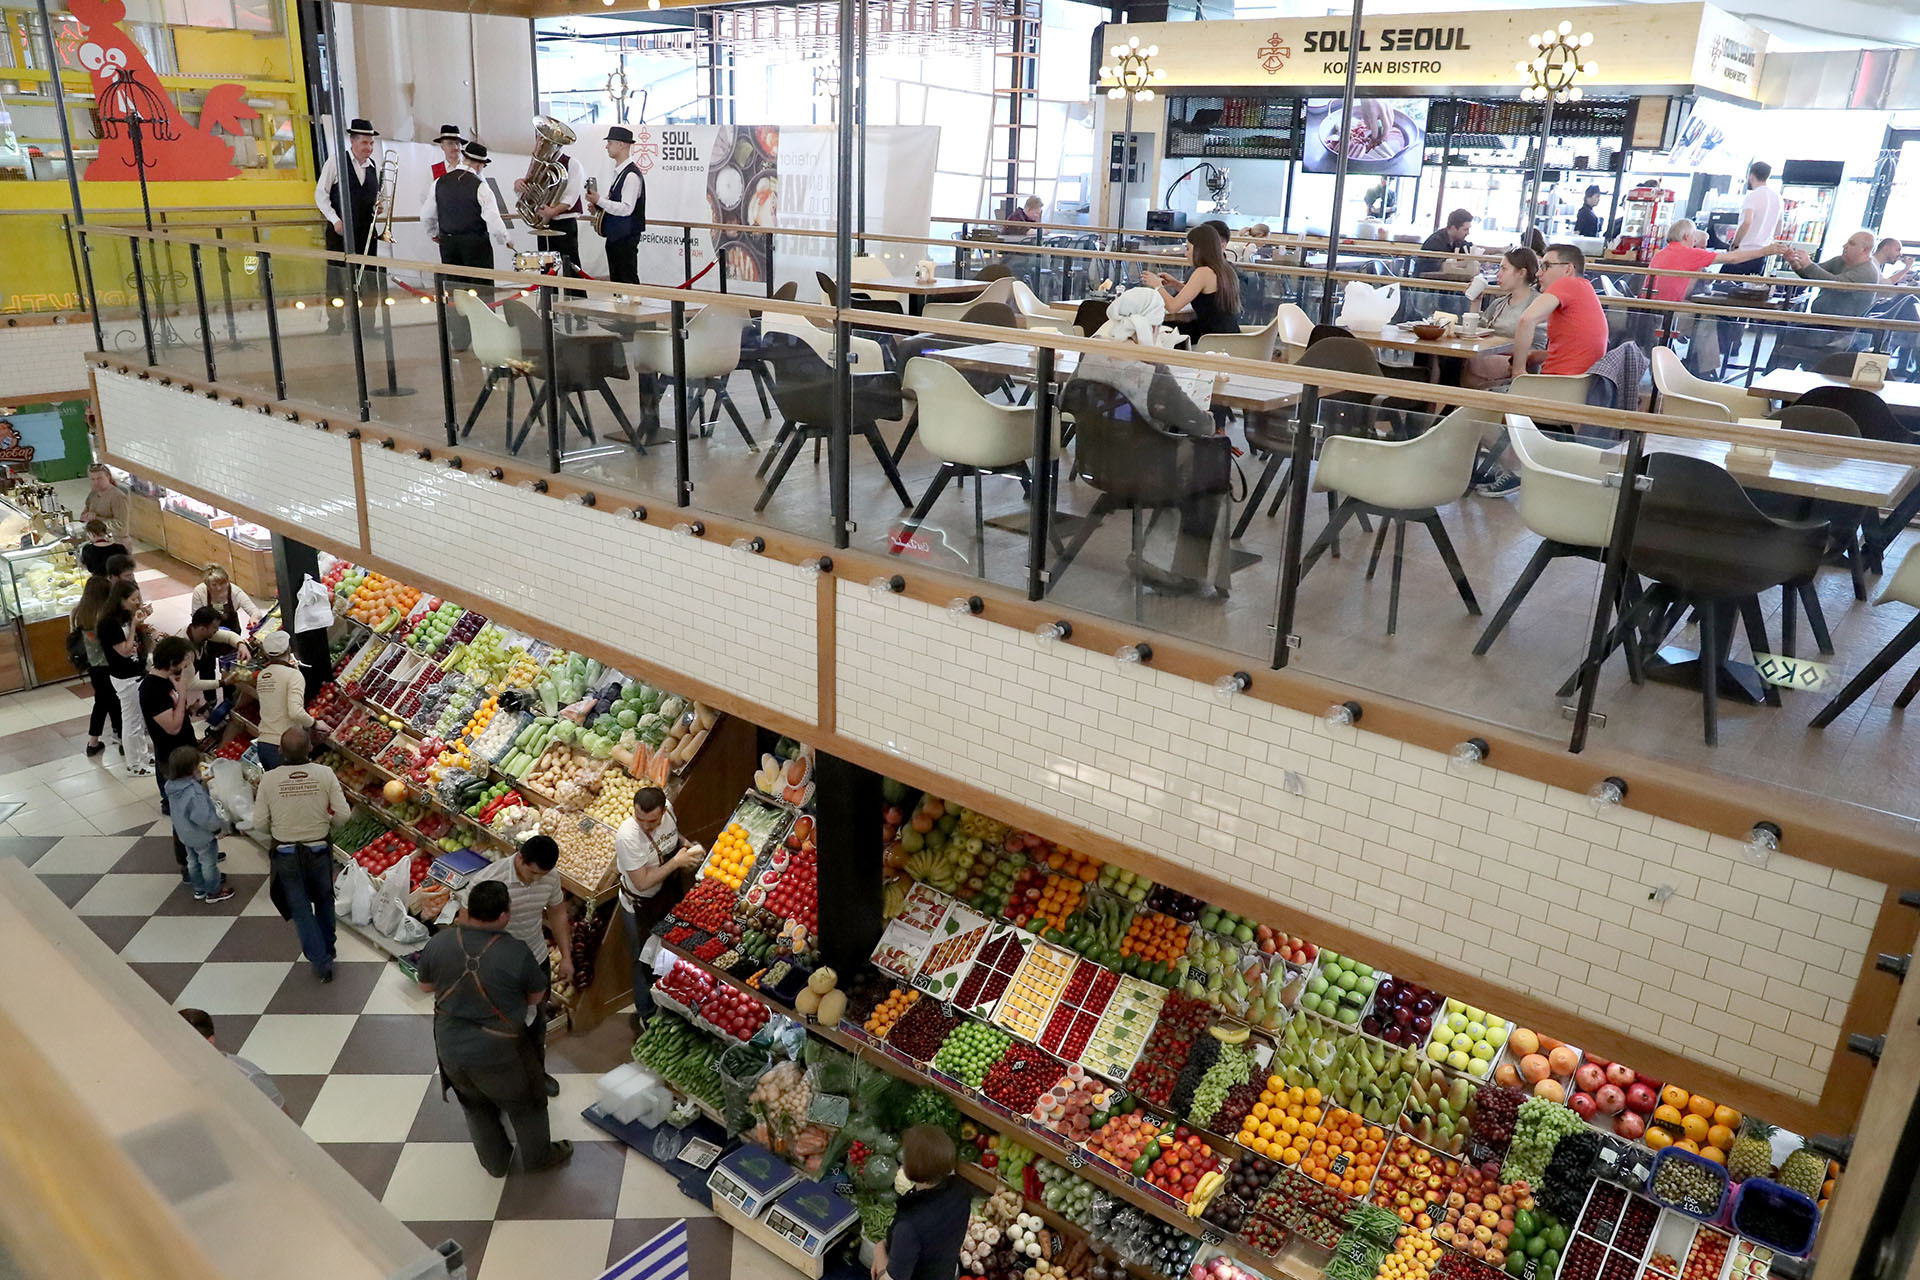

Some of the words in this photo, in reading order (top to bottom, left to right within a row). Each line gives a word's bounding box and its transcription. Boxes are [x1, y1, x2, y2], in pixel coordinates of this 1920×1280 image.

[1303, 30, 1371, 53] SOUL
[1380, 27, 1472, 51] SEOUL
[1323, 61, 1383, 74] KOEAN
[1387, 60, 1442, 74] BISTRO
[662, 131, 692, 145] SOUL
[662, 147, 699, 161] SEOUL
[640, 232, 673, 244] РЕЙСКАЯ
[673, 236, 699, 247] КУЯ
